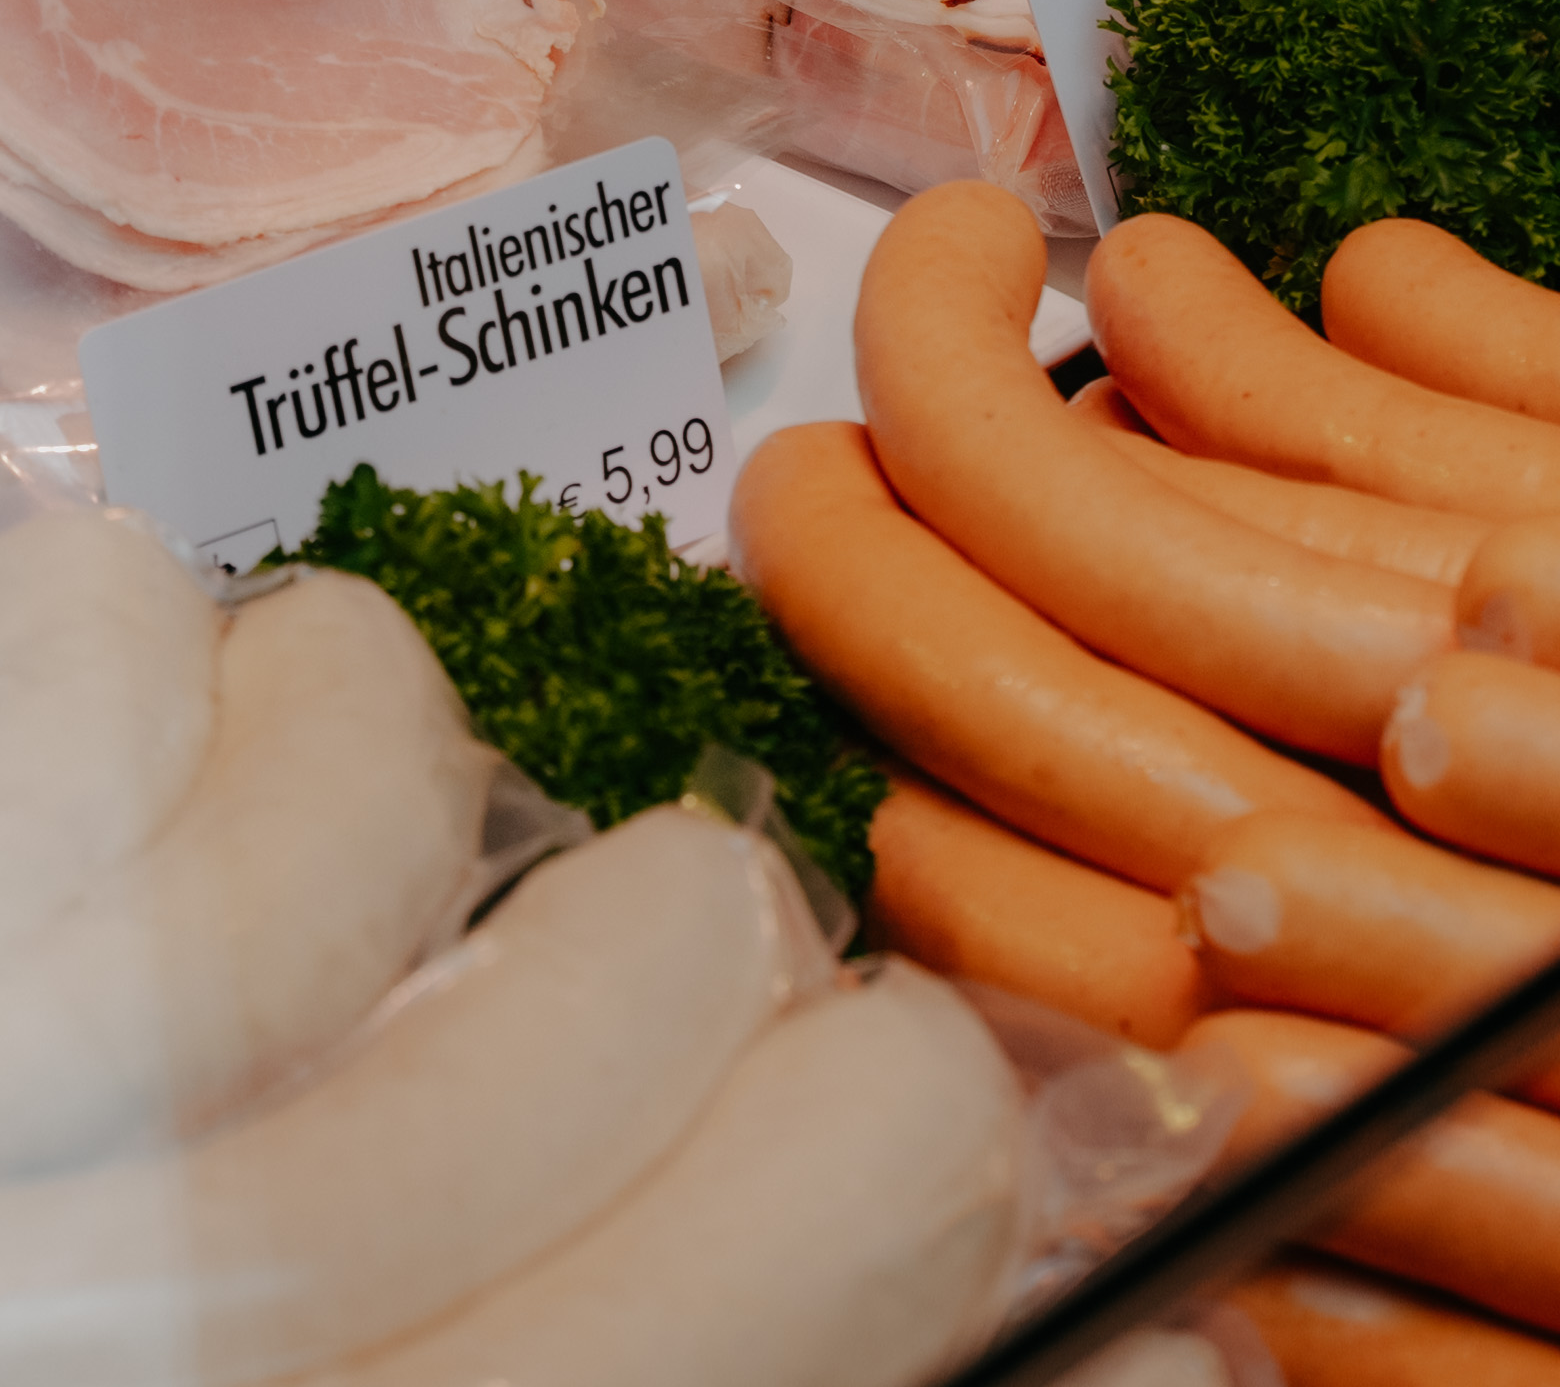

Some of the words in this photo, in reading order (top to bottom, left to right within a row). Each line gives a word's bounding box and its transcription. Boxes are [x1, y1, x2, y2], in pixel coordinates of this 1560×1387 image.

[412, 180, 671, 308] Italienischer
[229, 256, 690, 457] Trüffel-Schinken
[600, 417, 715, 506] 5,99
